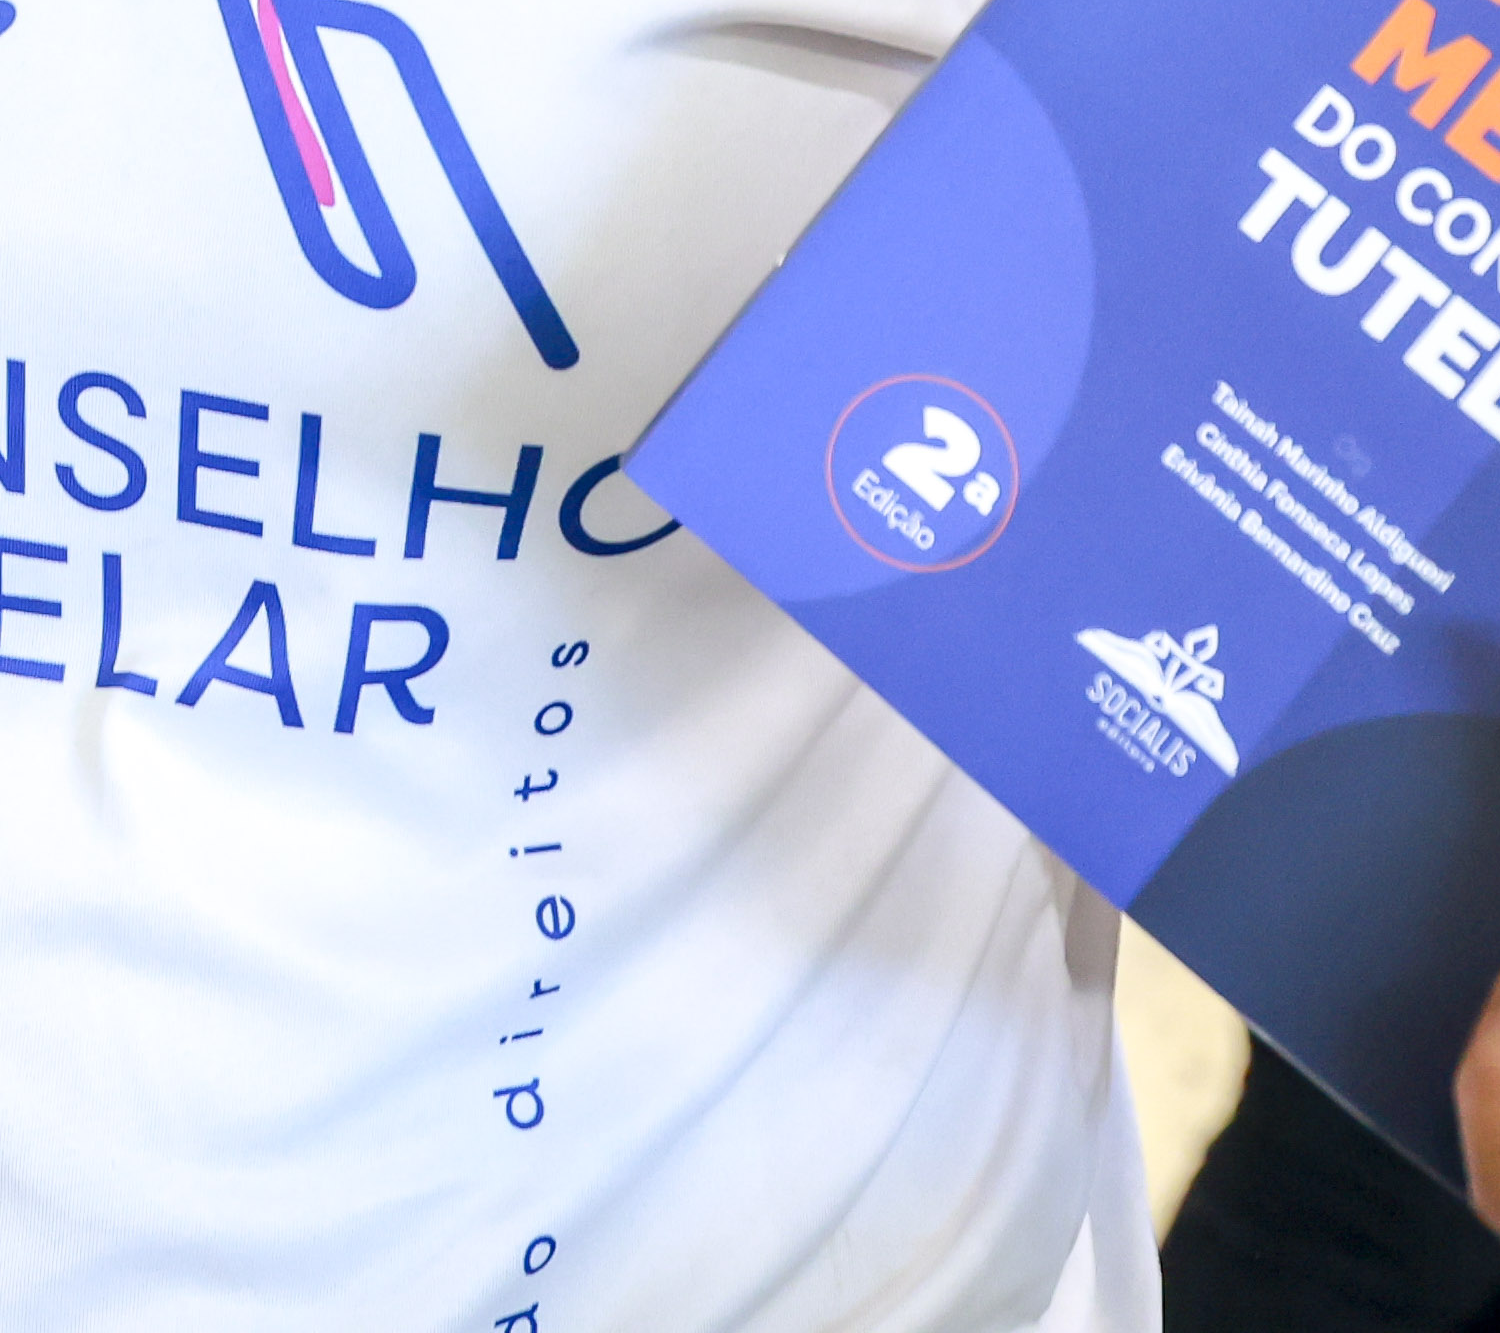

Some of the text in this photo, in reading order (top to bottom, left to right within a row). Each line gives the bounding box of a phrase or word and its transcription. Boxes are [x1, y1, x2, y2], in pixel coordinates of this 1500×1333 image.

[1293, 84, 1396, 181] DO
[852, 467, 935, 551] Edição
[1212, 379, 1278, 449] Tainah
[1275, 435, 1359, 516] Marinho
[1196, 421, 1415, 616] Cinthia Fonseca Lopes
[1238, 508, 1351, 614] Bernardino
[1348, 602, 1401, 656] Cruz
[1085, 671, 1197, 778] SOCIALIS
[494, 638, 591, 1131] direitos
